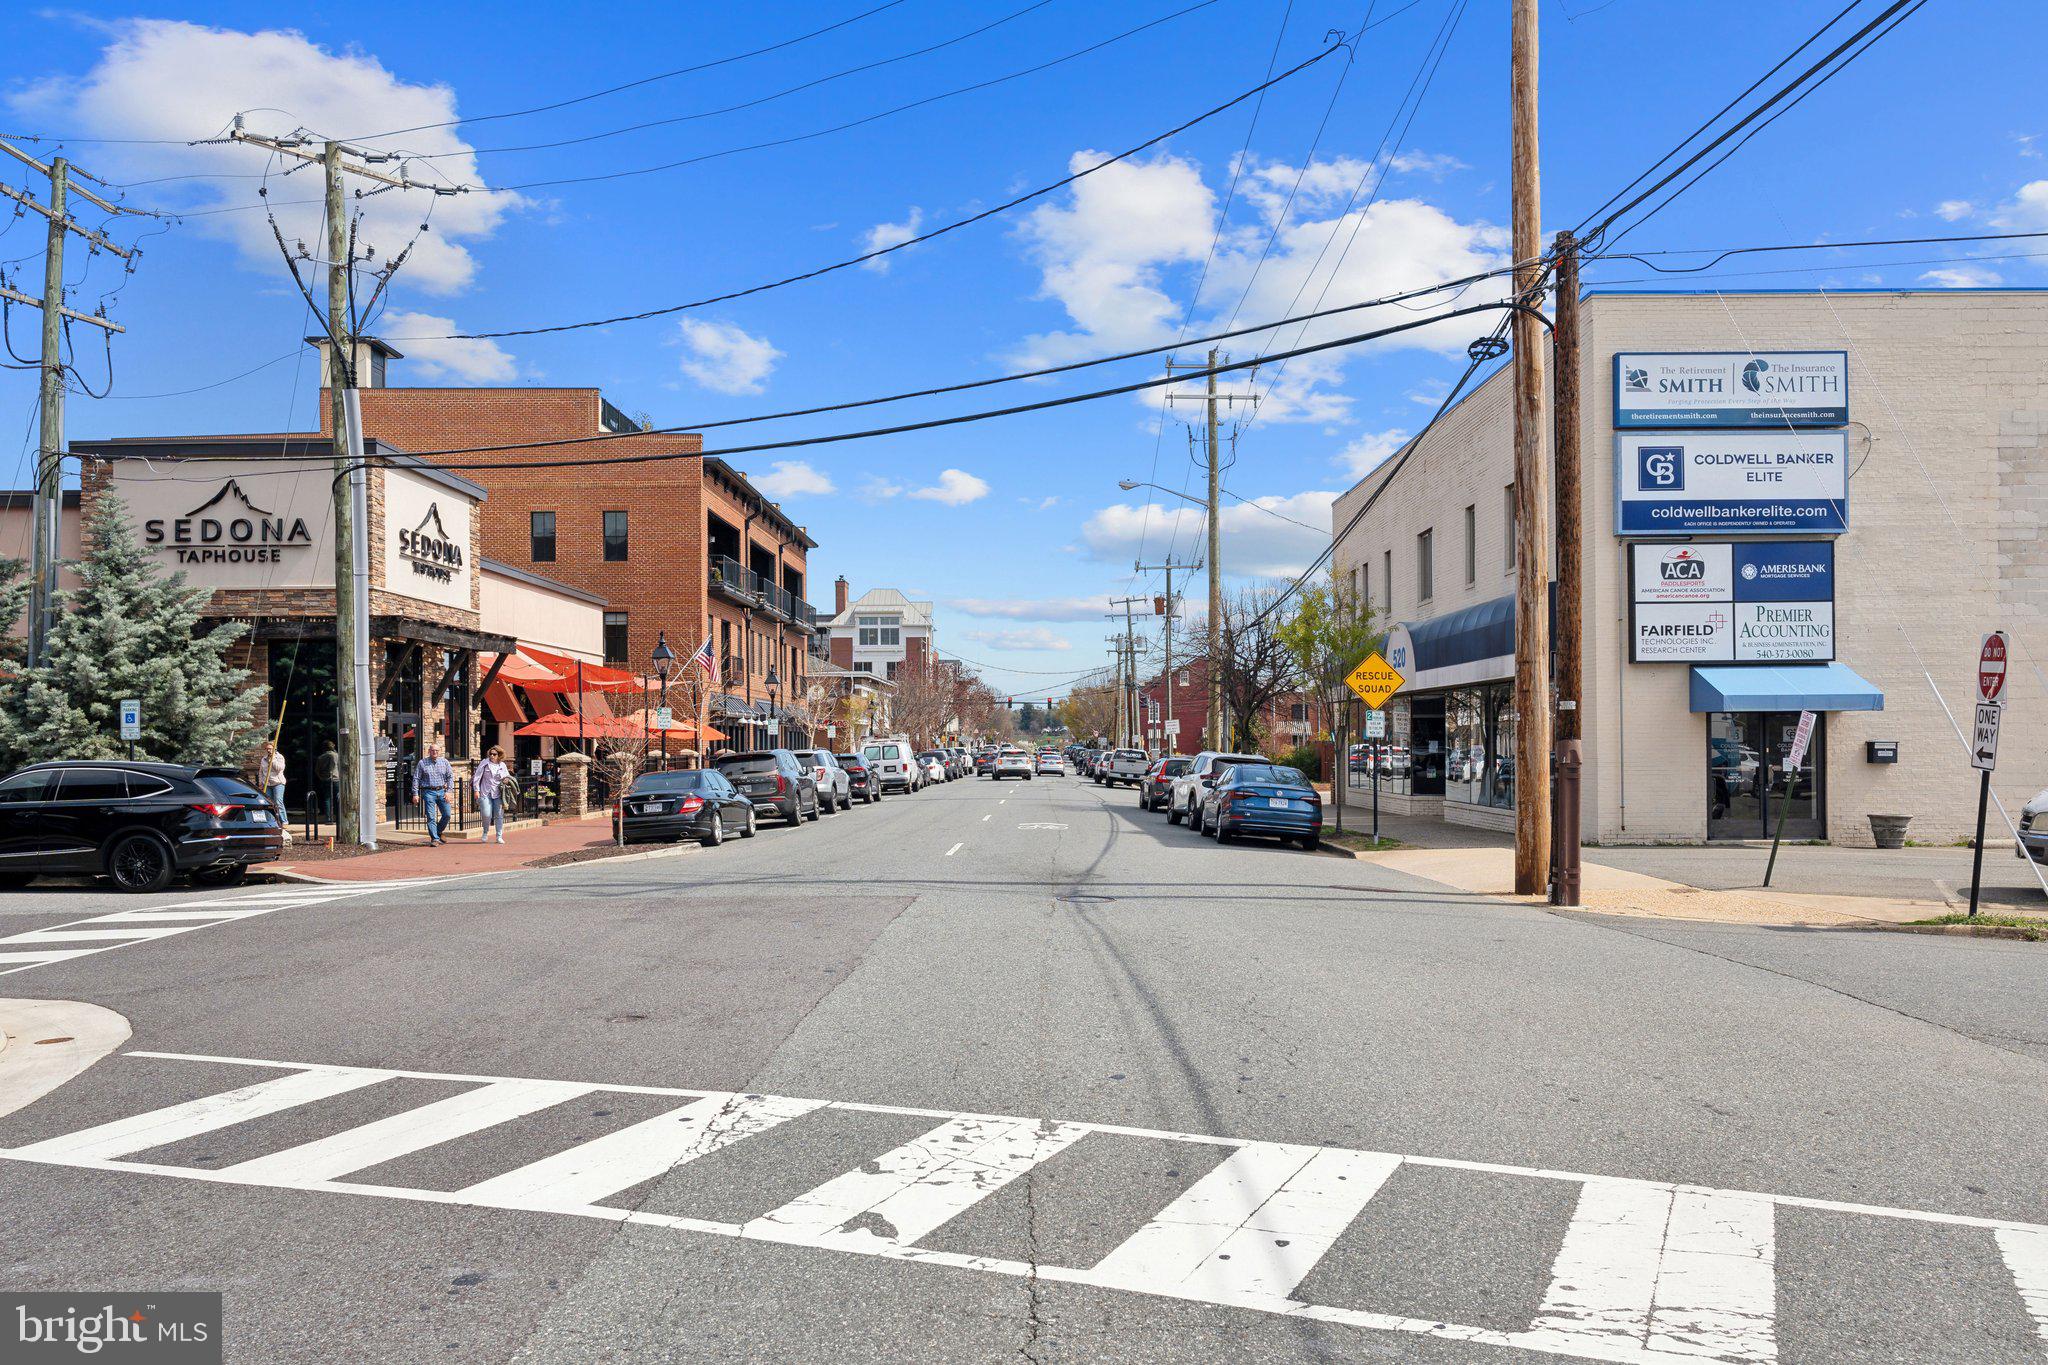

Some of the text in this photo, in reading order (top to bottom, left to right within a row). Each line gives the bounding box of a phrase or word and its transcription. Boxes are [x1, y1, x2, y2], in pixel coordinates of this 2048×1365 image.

[1680, 366, 1726, 374] Retirement
[1771, 364, 1835, 372] The Insurance
[1659, 378, 1723, 393] SMITH
[1766, 376, 1838, 393] SMITH
[1694, 453, 1834, 465] COLDWELL BANKER
[1747, 472, 1782, 482] ELITE
[1652, 506, 1827, 517] coldwellbankerelite.com
[145, 518, 312, 542] SEDONA
[399, 528, 462, 566] SEDONA
[177, 549, 280, 563] TAPHOUSE
[1665, 563, 1701, 578] ACA
[1760, 564, 1826, 573] AMERIS BANK
[1756, 606, 1813, 622] PREMIER
[1641, 625, 1714, 636] FAIRFIELD
[1740, 622, 1830, 638] ACCOUNTING
[1393, 647, 1406, 669] 520
[1757, 649, 1814, 658] 540-373-0080
[1984, 647, 2004, 657] DO NOT
[1356, 672, 1393, 680] RESCUE
[1358, 685, 1391, 693] SQUAD
[1979, 709, 1997, 725] ONE
[1977, 727, 1996, 744] WAY
